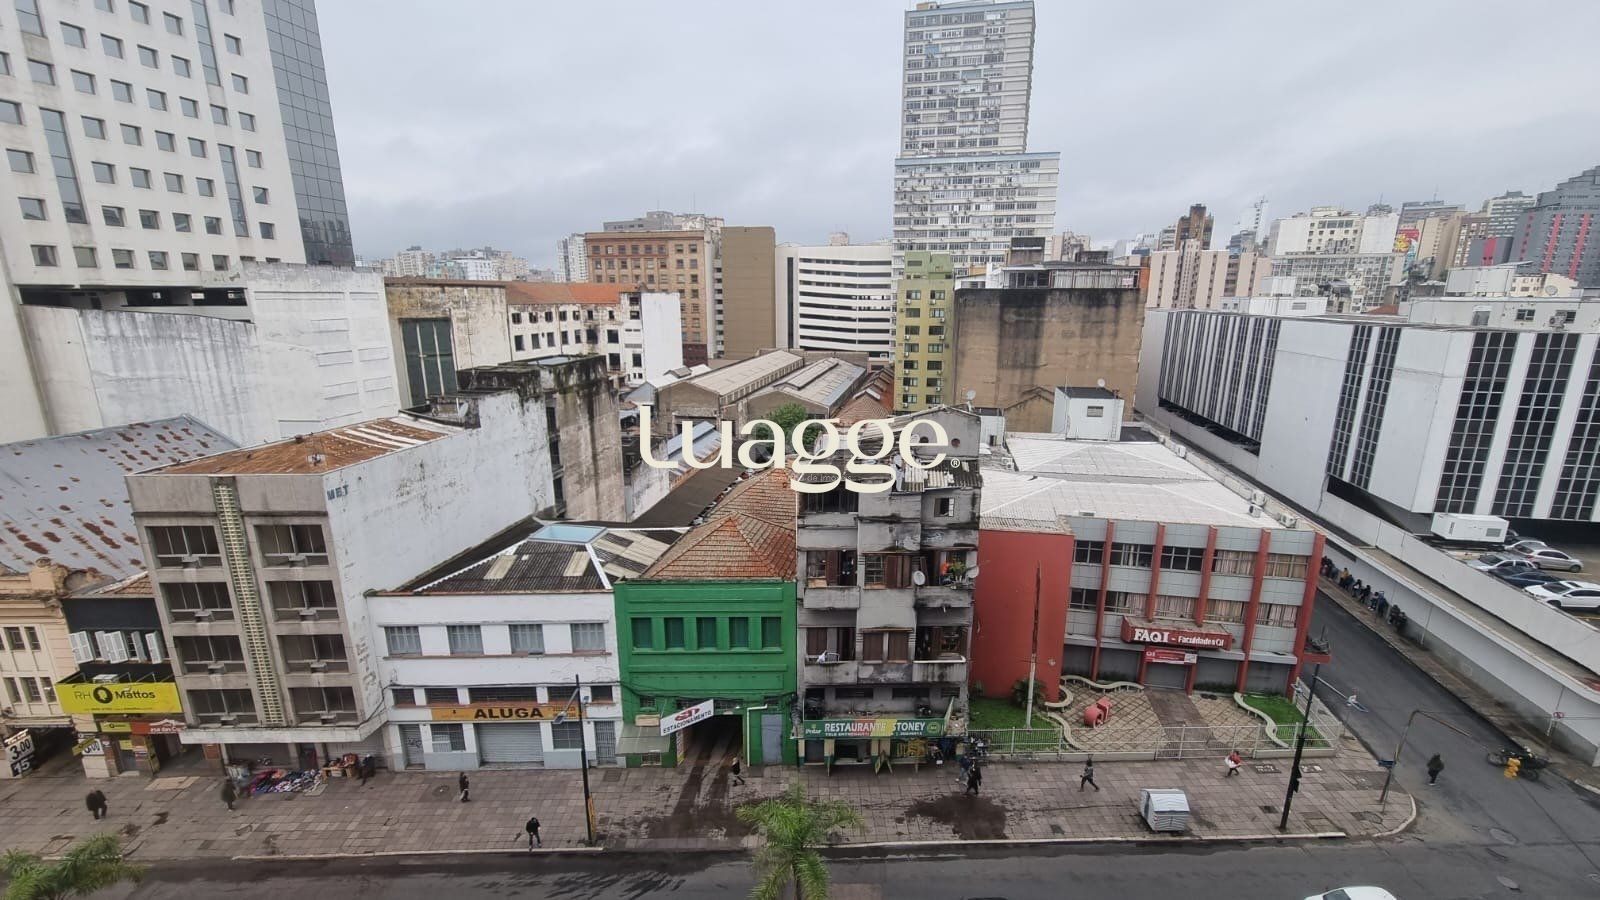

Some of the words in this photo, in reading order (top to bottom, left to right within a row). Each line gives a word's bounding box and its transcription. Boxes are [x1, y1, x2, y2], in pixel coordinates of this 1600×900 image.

[1134, 628, 1170, 643] FAQI
[1178, 635, 1215, 645] Faculdades
[74, 691, 91, 700] RH
[114, 689, 156, 699] Mattos
[474, 707, 544, 719] ALUGA
[663, 710, 712, 734] ESTACIONAMENTO
[824, 722, 887, 732] RESTAURANTE
